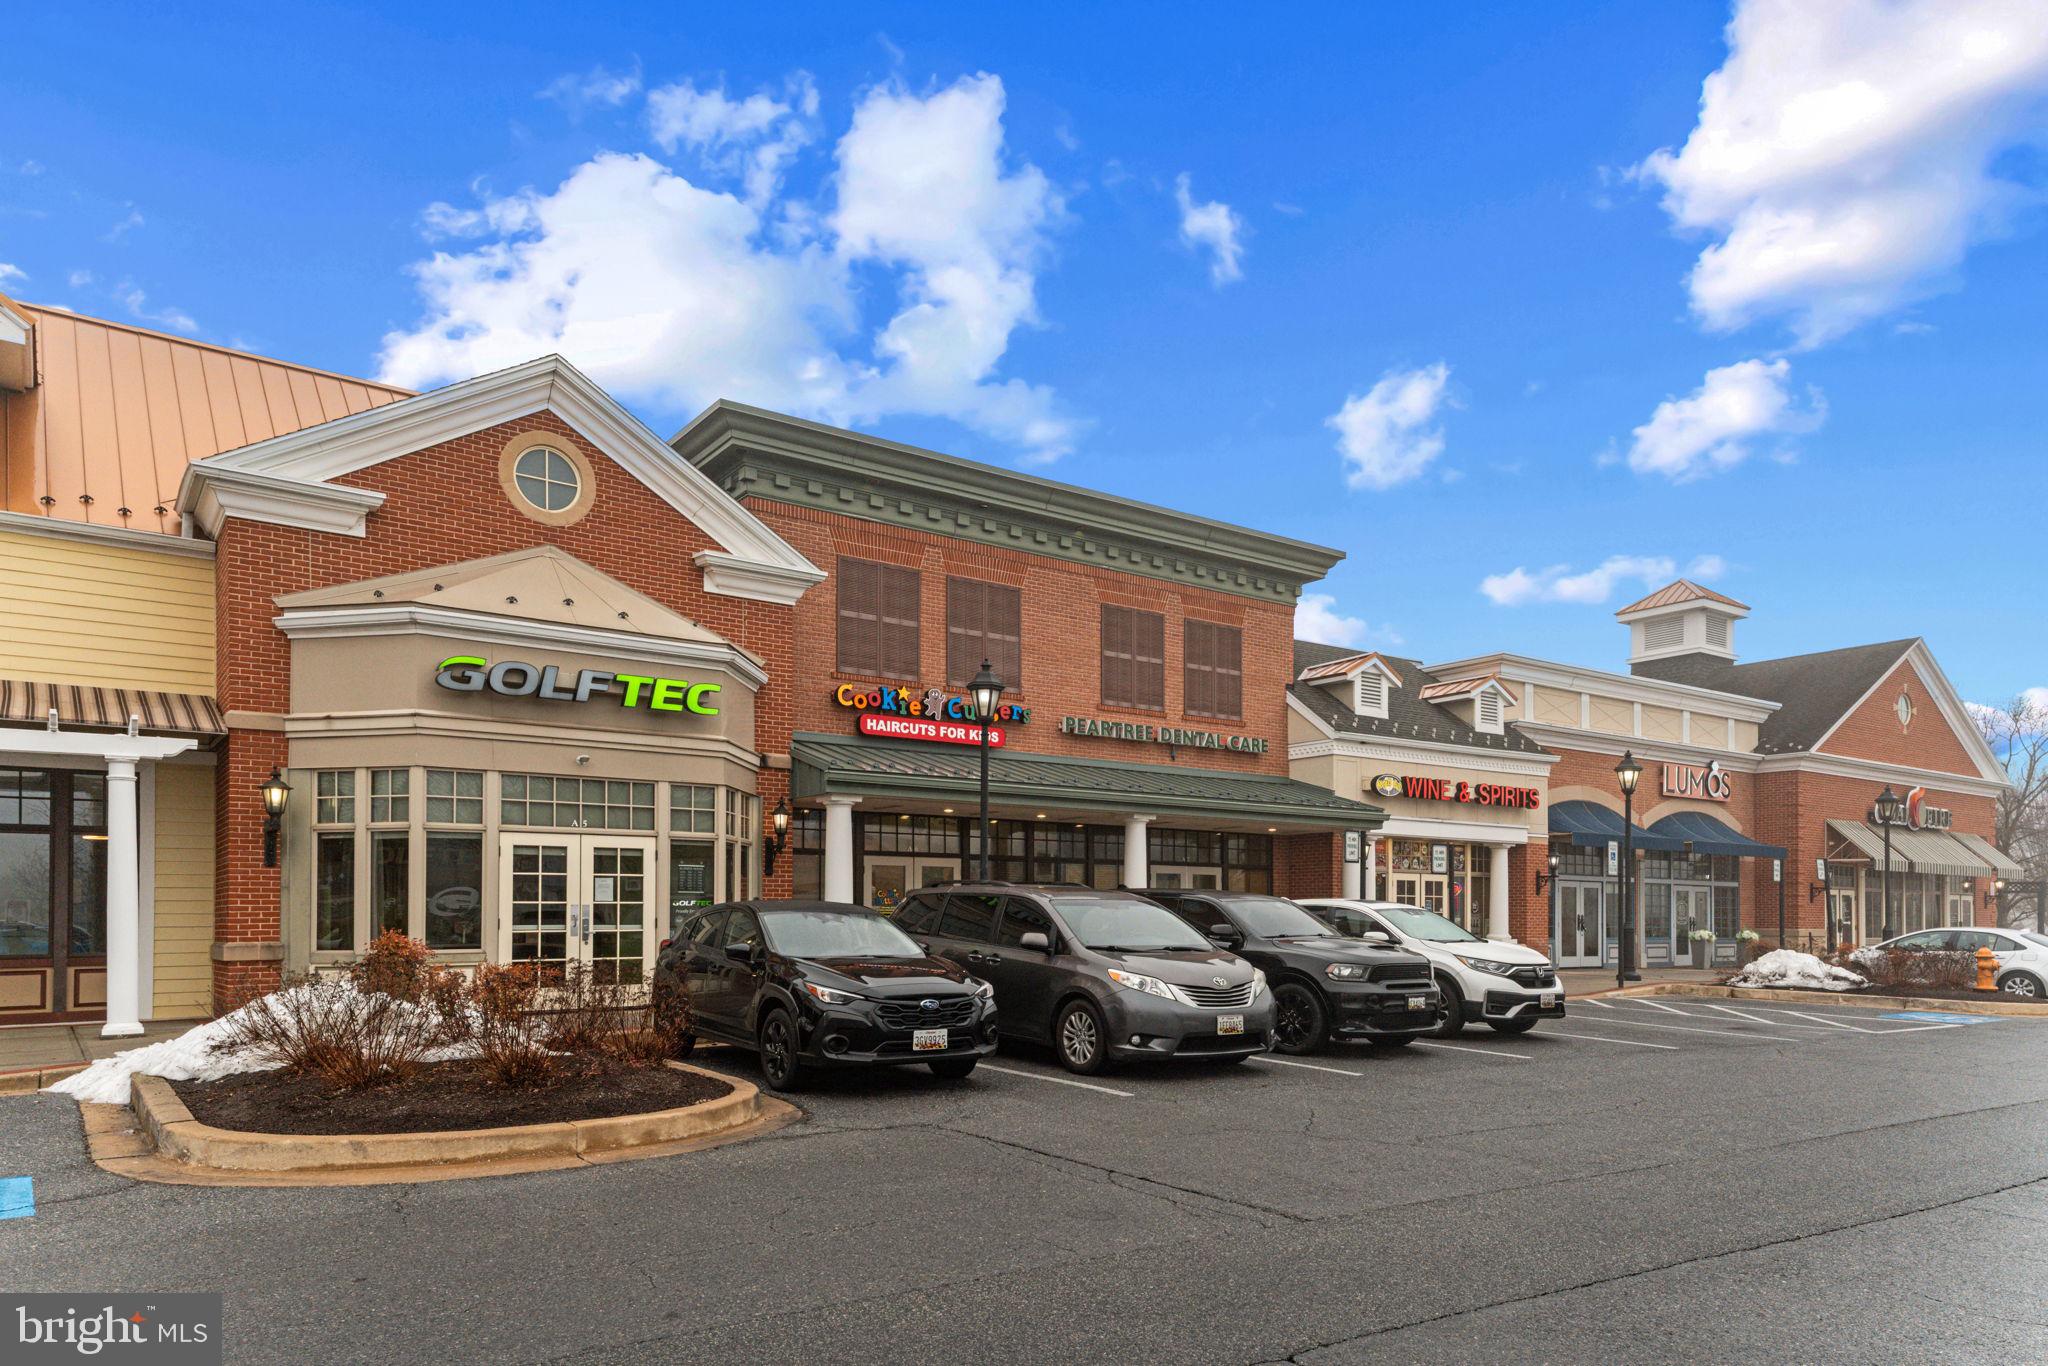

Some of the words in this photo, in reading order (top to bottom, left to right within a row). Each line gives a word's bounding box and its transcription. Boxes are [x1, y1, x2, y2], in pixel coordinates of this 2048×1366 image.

[435, 655, 722, 716] GOLFTEC
[834, 683, 922, 717] Cookie
[946, 697, 1032, 725] Cuers
[866, 718, 936, 737] HAIRCUTS
[939, 726, 966, 740] FOR
[1062, 716, 1154, 741] PEARTREE
[1158, 726, 1226, 749] DENTAL
[1228, 734, 1269, 753] CARE
[1405, 776, 1451, 801] WINE
[1457, 781, 1471, 803] &
[1477, 783, 1540, 810] SPIRITS
[1664, 763, 1731, 799] LUMOS
